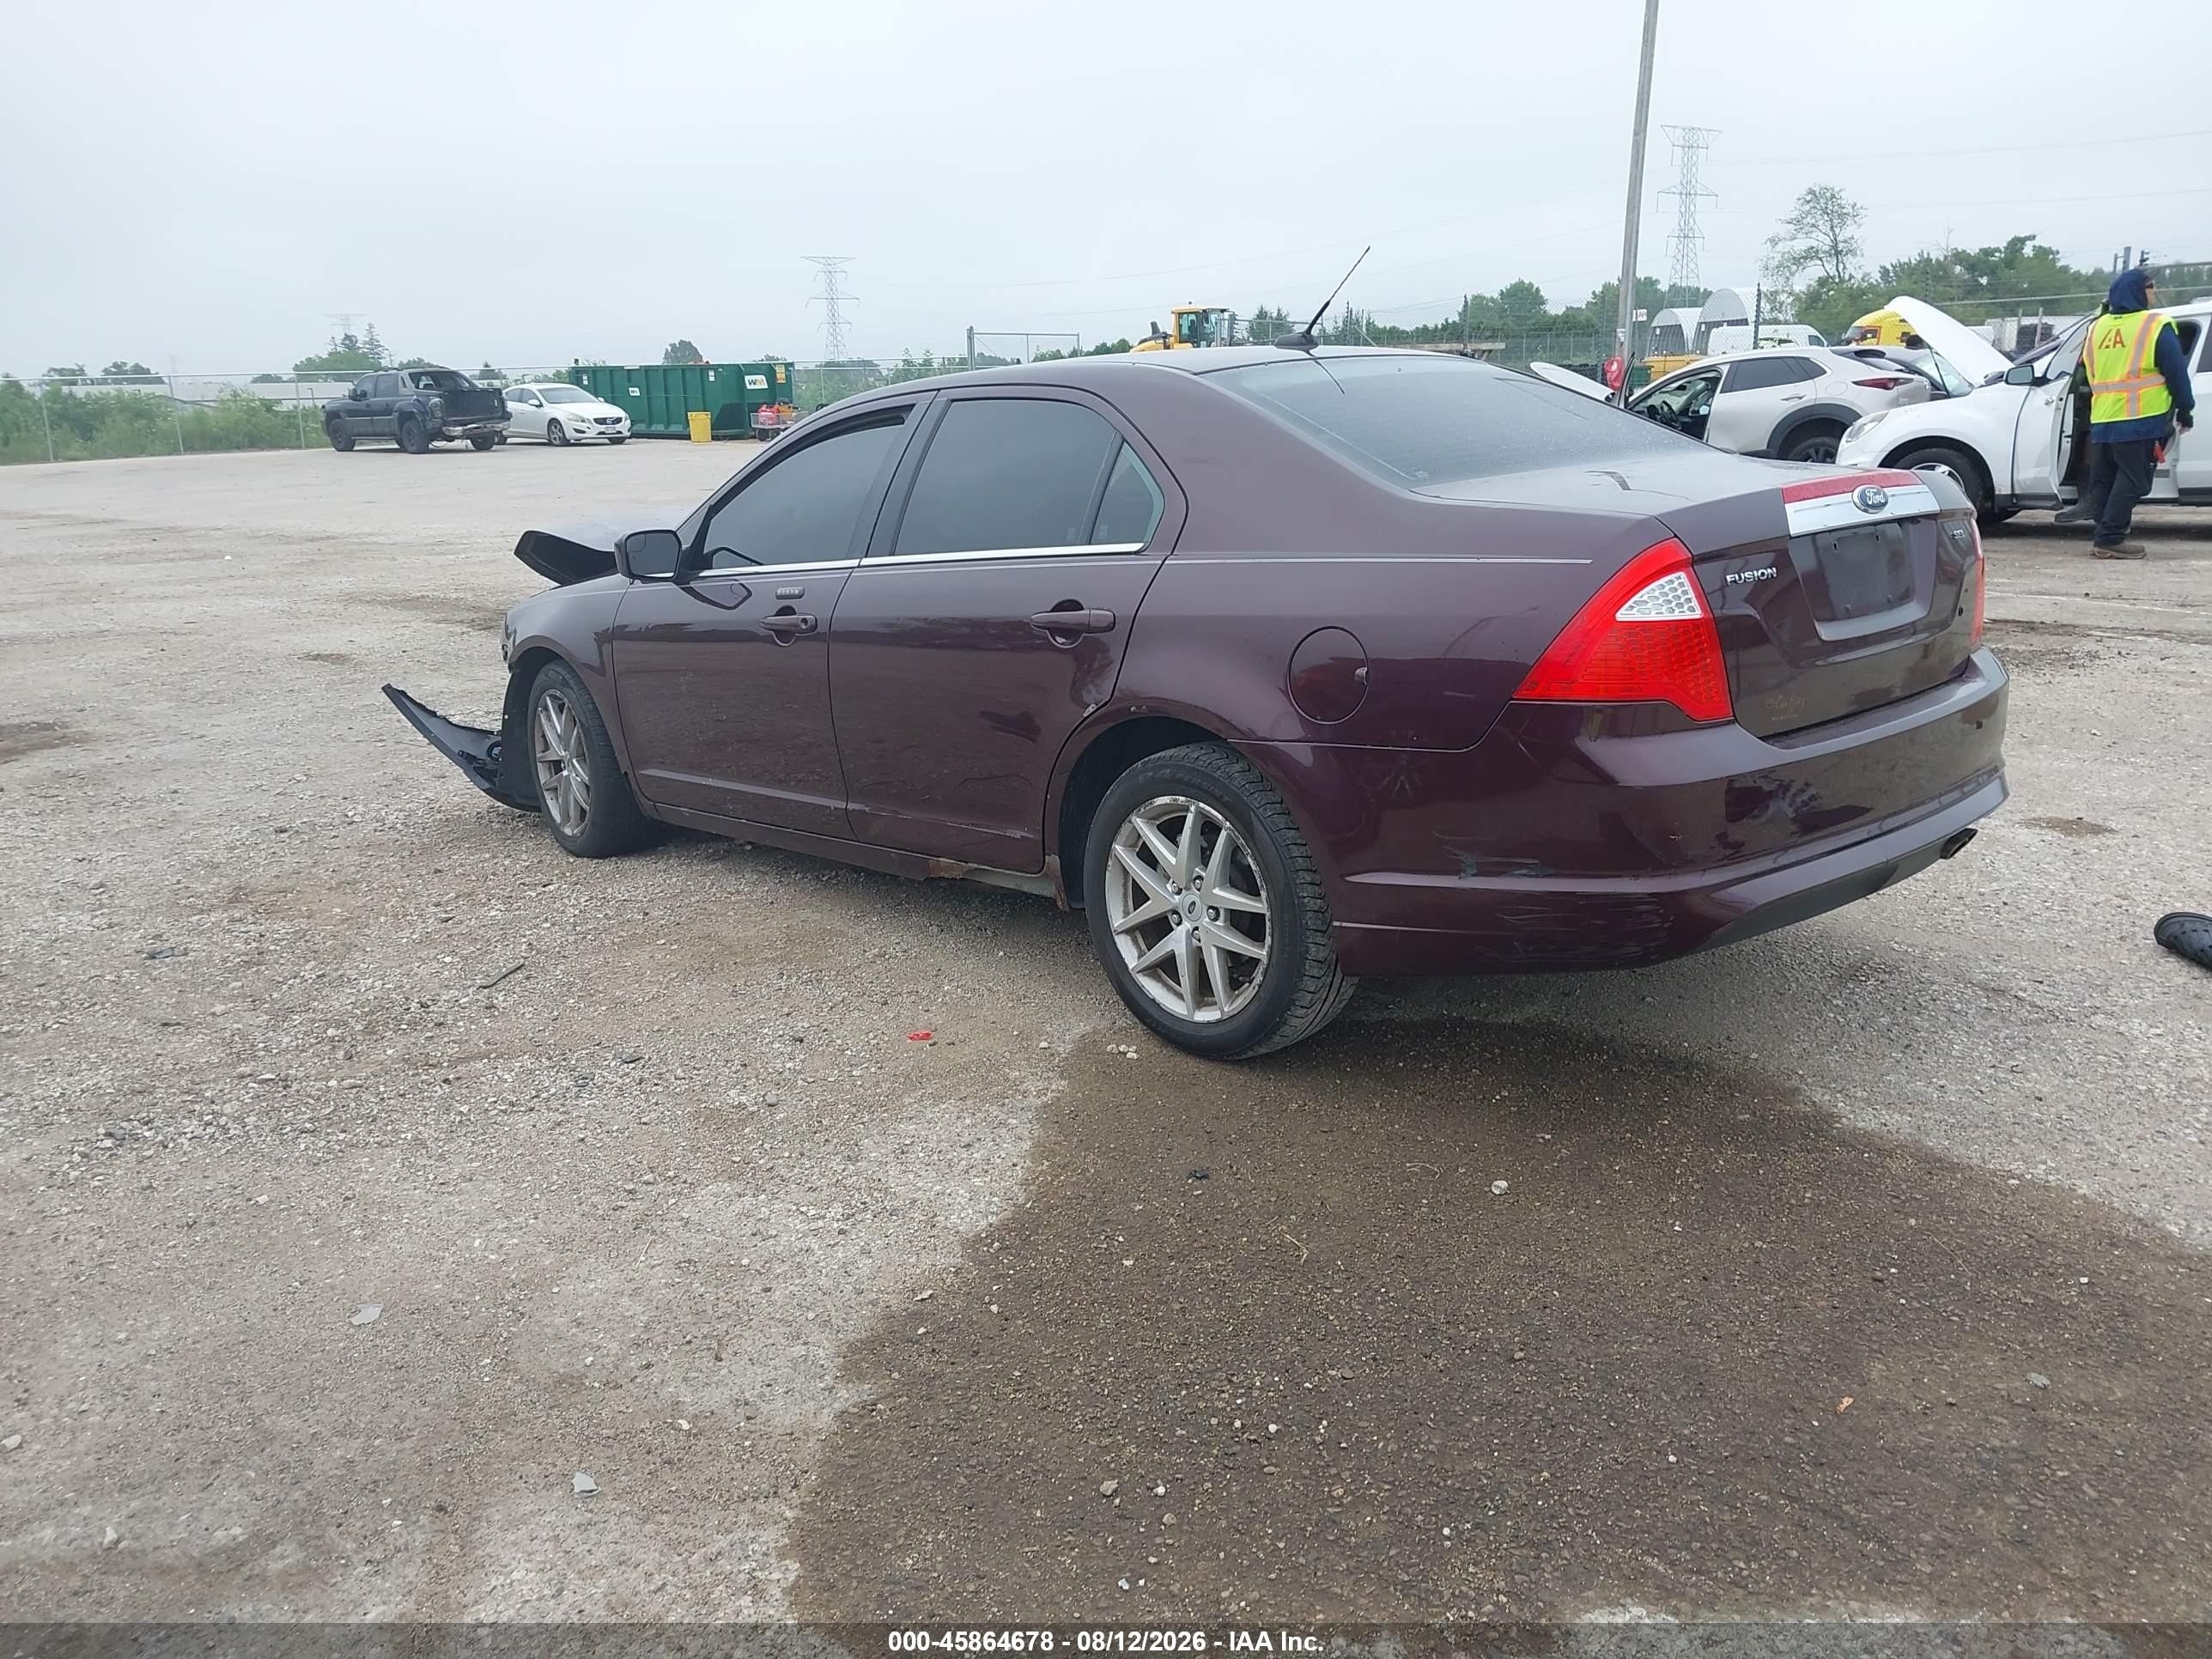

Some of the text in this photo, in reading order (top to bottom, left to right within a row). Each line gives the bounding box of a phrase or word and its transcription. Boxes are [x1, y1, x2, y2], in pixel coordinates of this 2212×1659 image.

[748, 378, 765, 386] WM
[1865, 489, 1886, 505] Ford
[1725, 567, 1777, 585] FUSION
